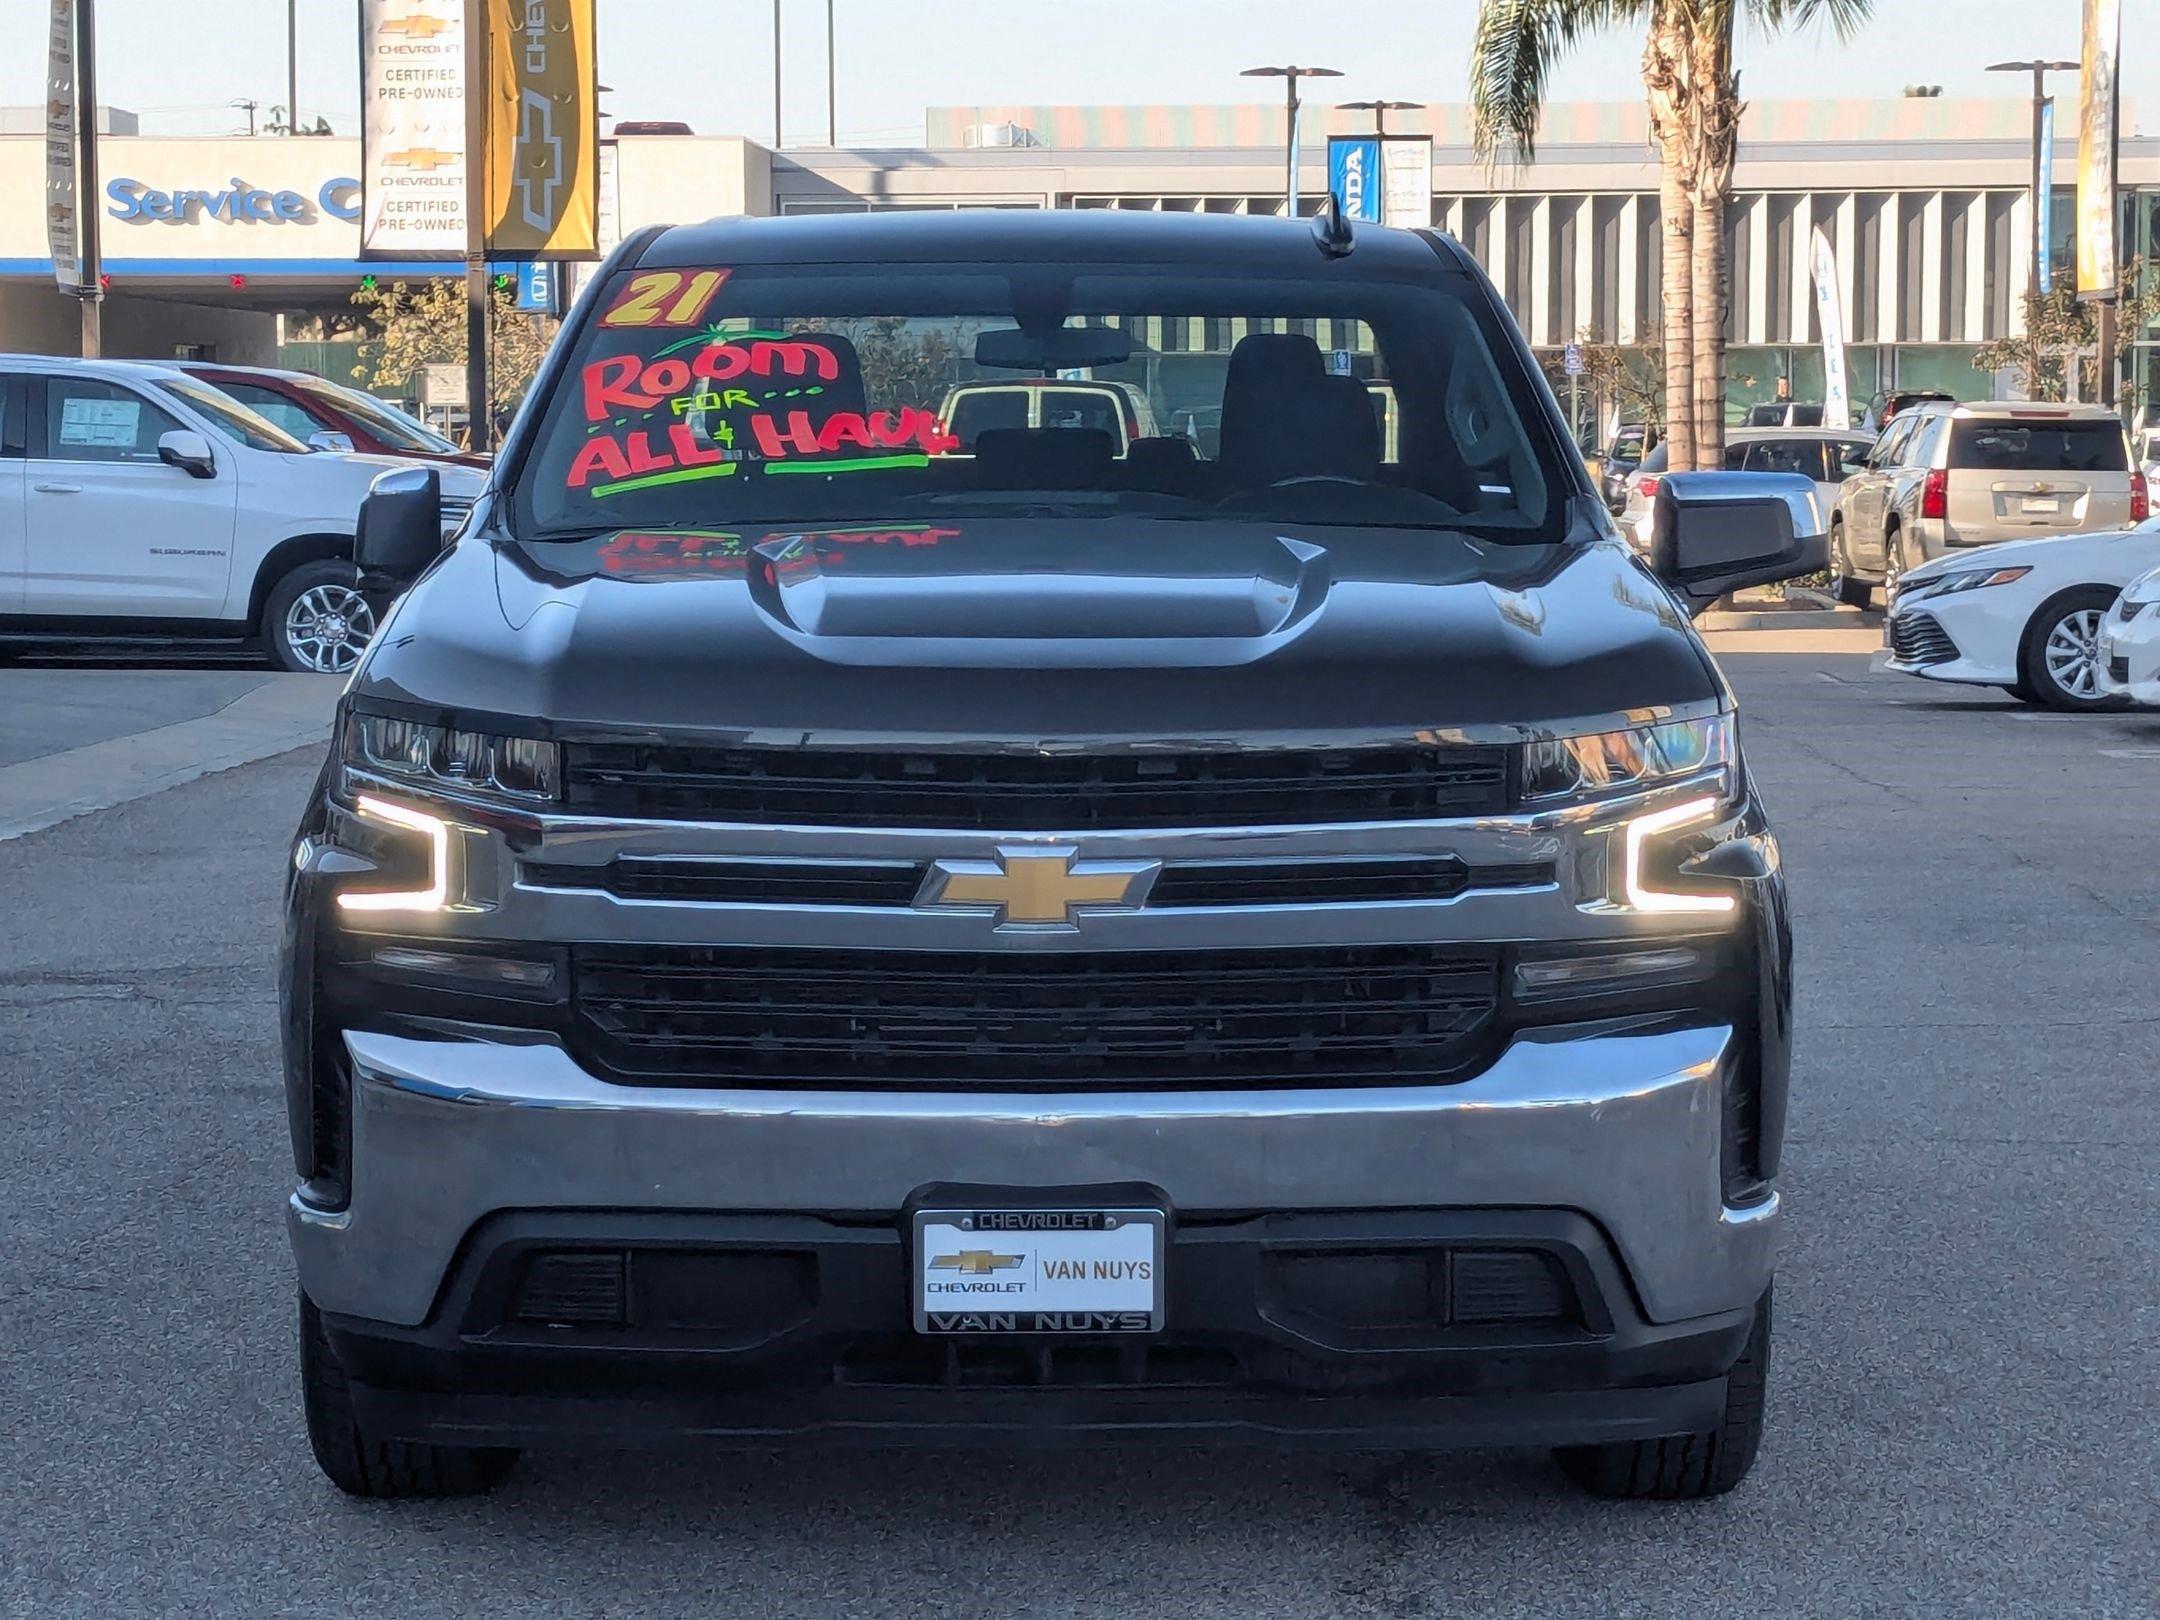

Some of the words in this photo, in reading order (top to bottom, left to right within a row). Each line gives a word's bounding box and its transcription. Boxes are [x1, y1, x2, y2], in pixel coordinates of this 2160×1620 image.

[525, 0, 545, 73] CHE
[378, 44, 460, 55] CHEVROLET
[385, 68, 456, 81] CERTIFIED
[378, 86, 464, 100] PRE-OWNED
[380, 176, 464, 186] CHEVROLET
[1345, 146, 1363, 218] NDA
[106, 177, 304, 220] Service
[318, 177, 362, 219] C
[386, 200, 459, 213] CERTIFIED
[378, 218, 465, 231] PRE-OWNED
[605, 271, 721, 326] 21
[671, 389, 760, 416] FOR
[567, 424, 724, 487] ALL
[750, 406, 960, 457] HAUL
[979, 1213, 1098, 1229] CHEVROLET
[1043, 1261, 1086, 1280] VAN
[1093, 1261, 1151, 1280] NUYS
[927, 1282, 1027, 1293] CHEVROLET
[928, 1312, 1016, 1330] VAN
[1035, 1312, 1148, 1330] NUYS
